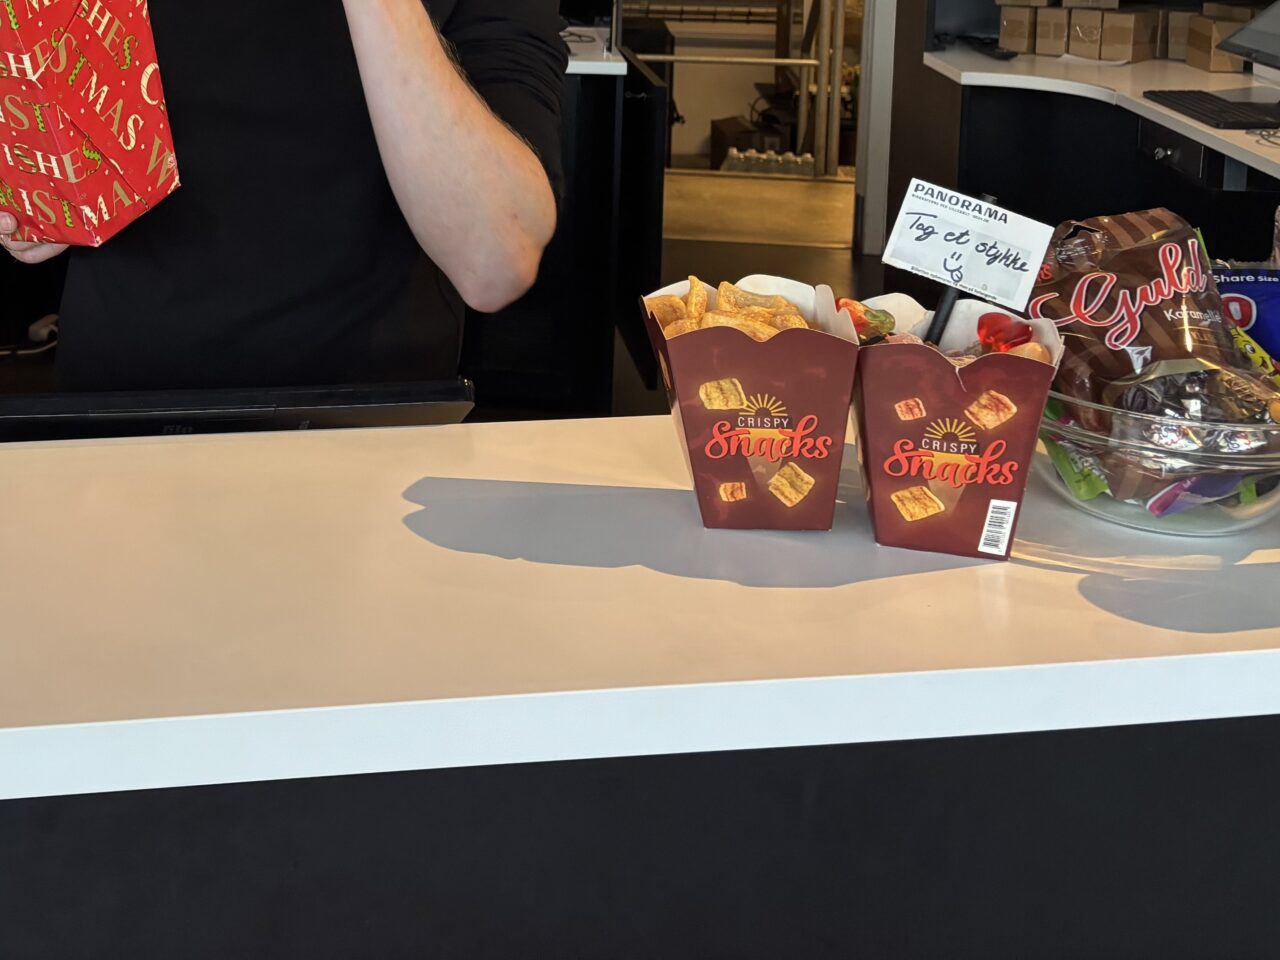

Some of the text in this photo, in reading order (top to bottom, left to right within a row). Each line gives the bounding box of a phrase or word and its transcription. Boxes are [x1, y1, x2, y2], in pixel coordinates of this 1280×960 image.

[914, 183, 1008, 224] PANORAMA
[905, 212, 939, 242] Tag
[943, 229, 970, 245] et
[975, 241, 1030, 273] stykke
[1028, 238, 1207, 351] Guld
[704, 414, 833, 462] Snacks
[737, 416, 789, 428] CRISPY
[921, 438, 978, 454] CRISPY
[883, 439, 1019, 488] Snacks
